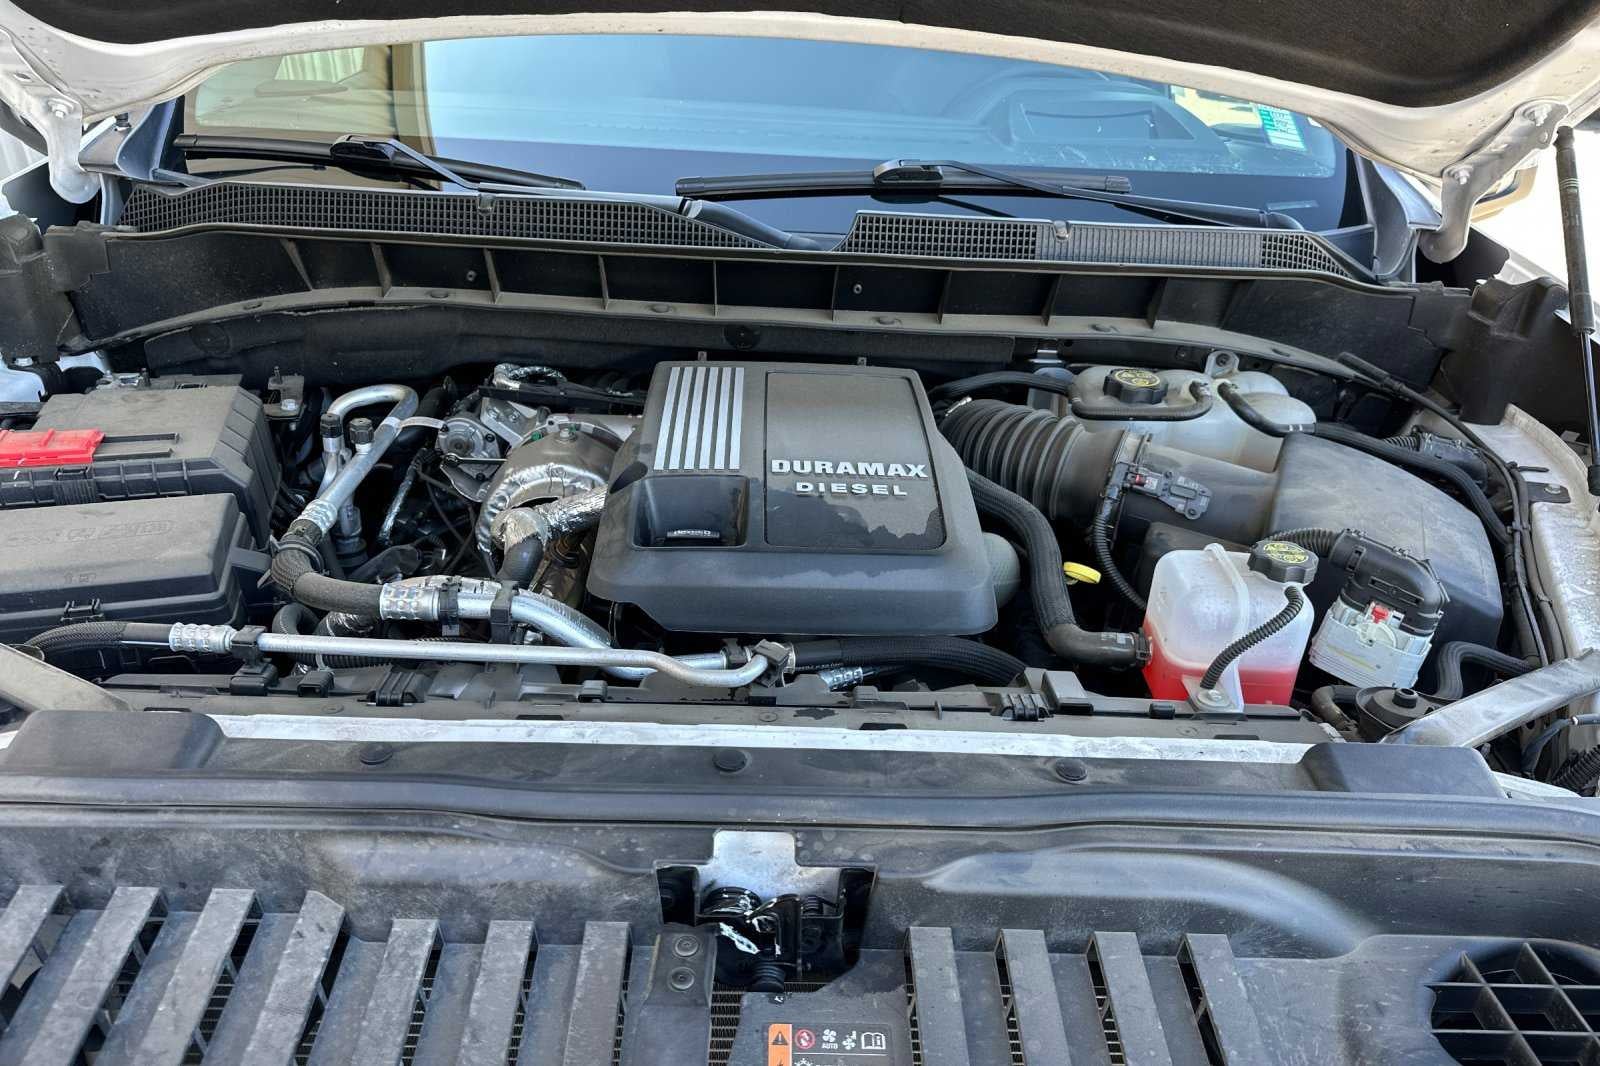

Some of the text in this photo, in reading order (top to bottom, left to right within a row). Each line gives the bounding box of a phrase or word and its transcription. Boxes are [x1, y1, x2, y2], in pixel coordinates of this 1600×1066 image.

[771, 459, 928, 478] DURAMAX
[796, 482, 908, 496] DIESEL
[821, 1042, 838, 1050] AUTO
